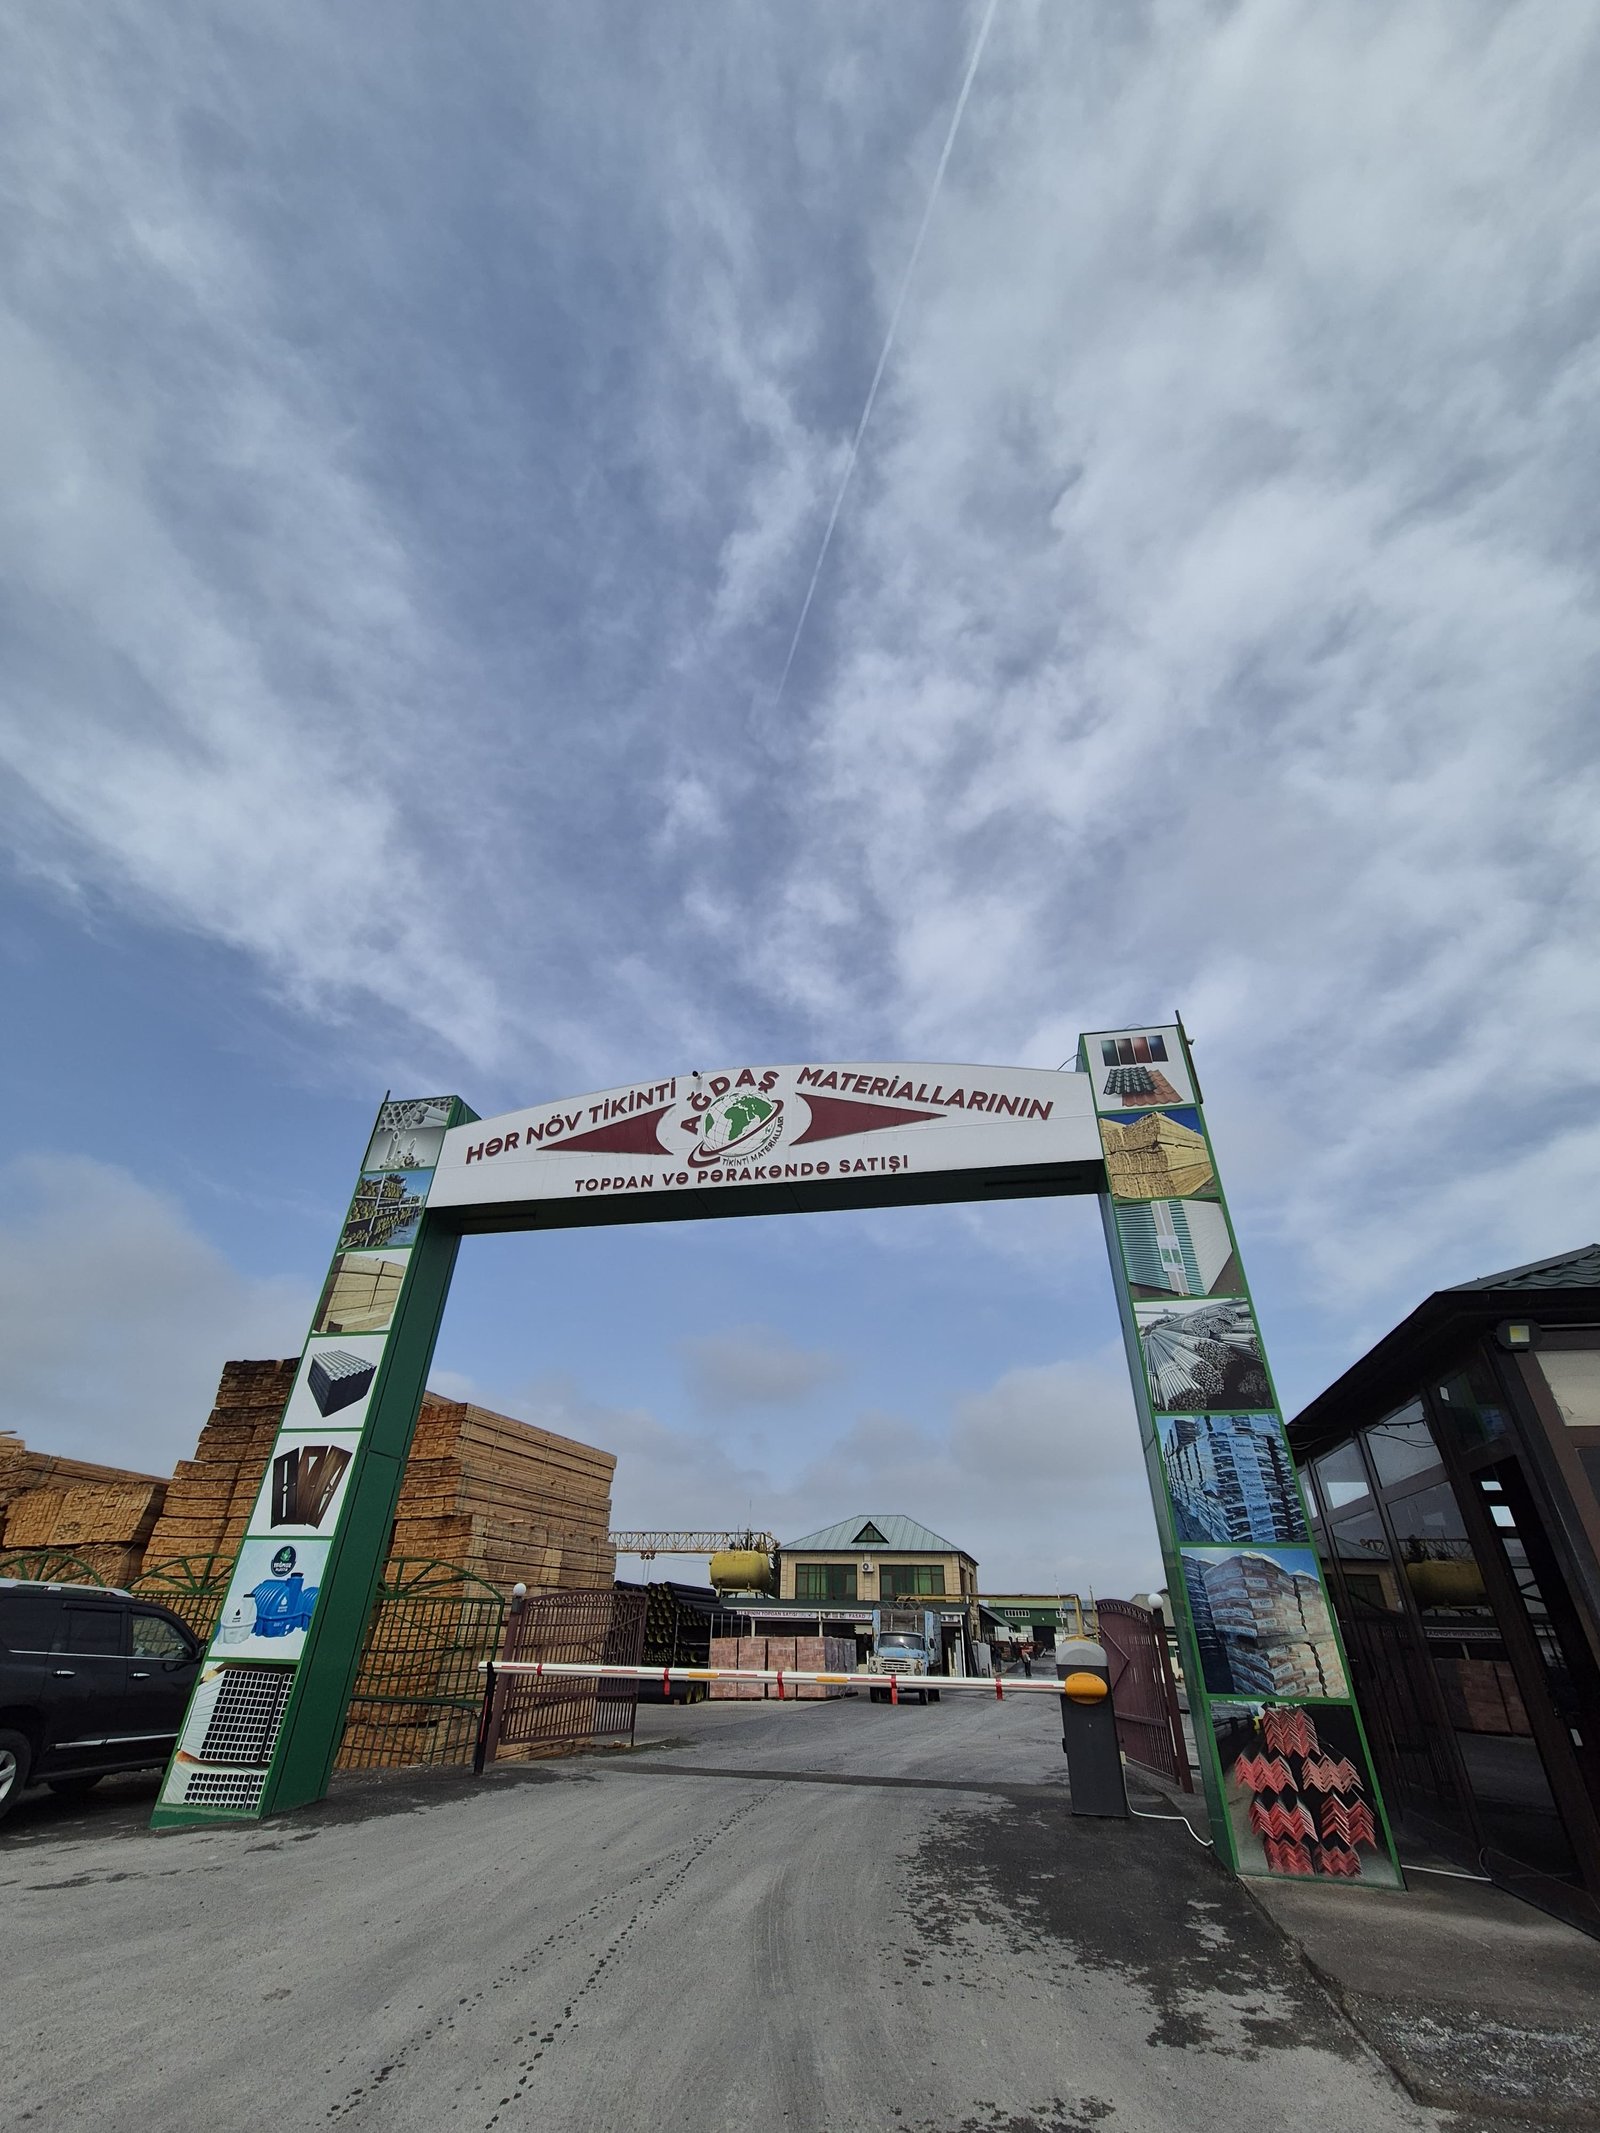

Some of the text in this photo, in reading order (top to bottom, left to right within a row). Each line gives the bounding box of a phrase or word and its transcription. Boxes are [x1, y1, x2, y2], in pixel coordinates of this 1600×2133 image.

[465, 1066, 1054, 1165] HƏR NÖV TİKİNTİ MATERİALLARININ
[680, 1068, 780, 1136] AĞDAŞ
[574, 1154, 909, 1193] TOPDAN VƏ PƏRAKƏNDƏ SATIŞI
